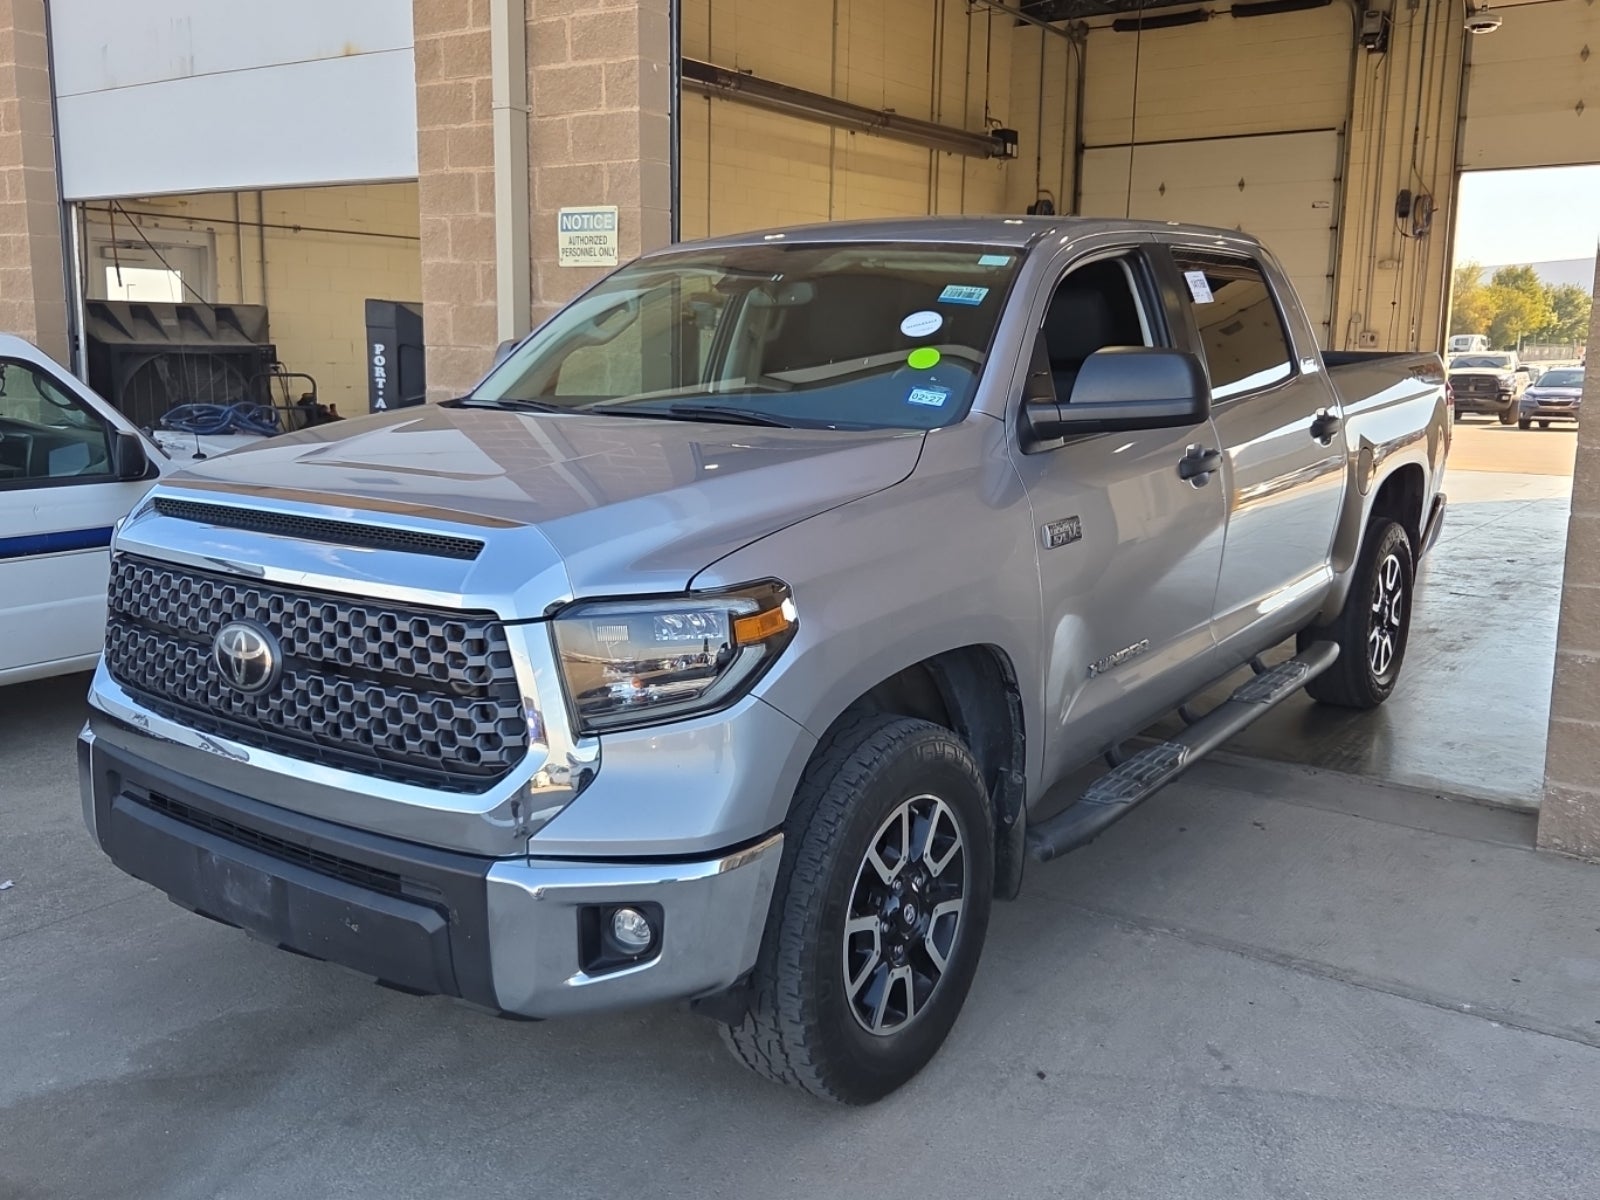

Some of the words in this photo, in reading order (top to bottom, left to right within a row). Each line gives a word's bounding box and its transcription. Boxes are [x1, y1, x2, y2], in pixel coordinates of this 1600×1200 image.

[562, 213, 613, 230] NOTICE
[568, 235, 608, 246] AUTHORIZED
[561, 247, 597, 257] PERSONNEL
[598, 246, 616, 256] ONLY
